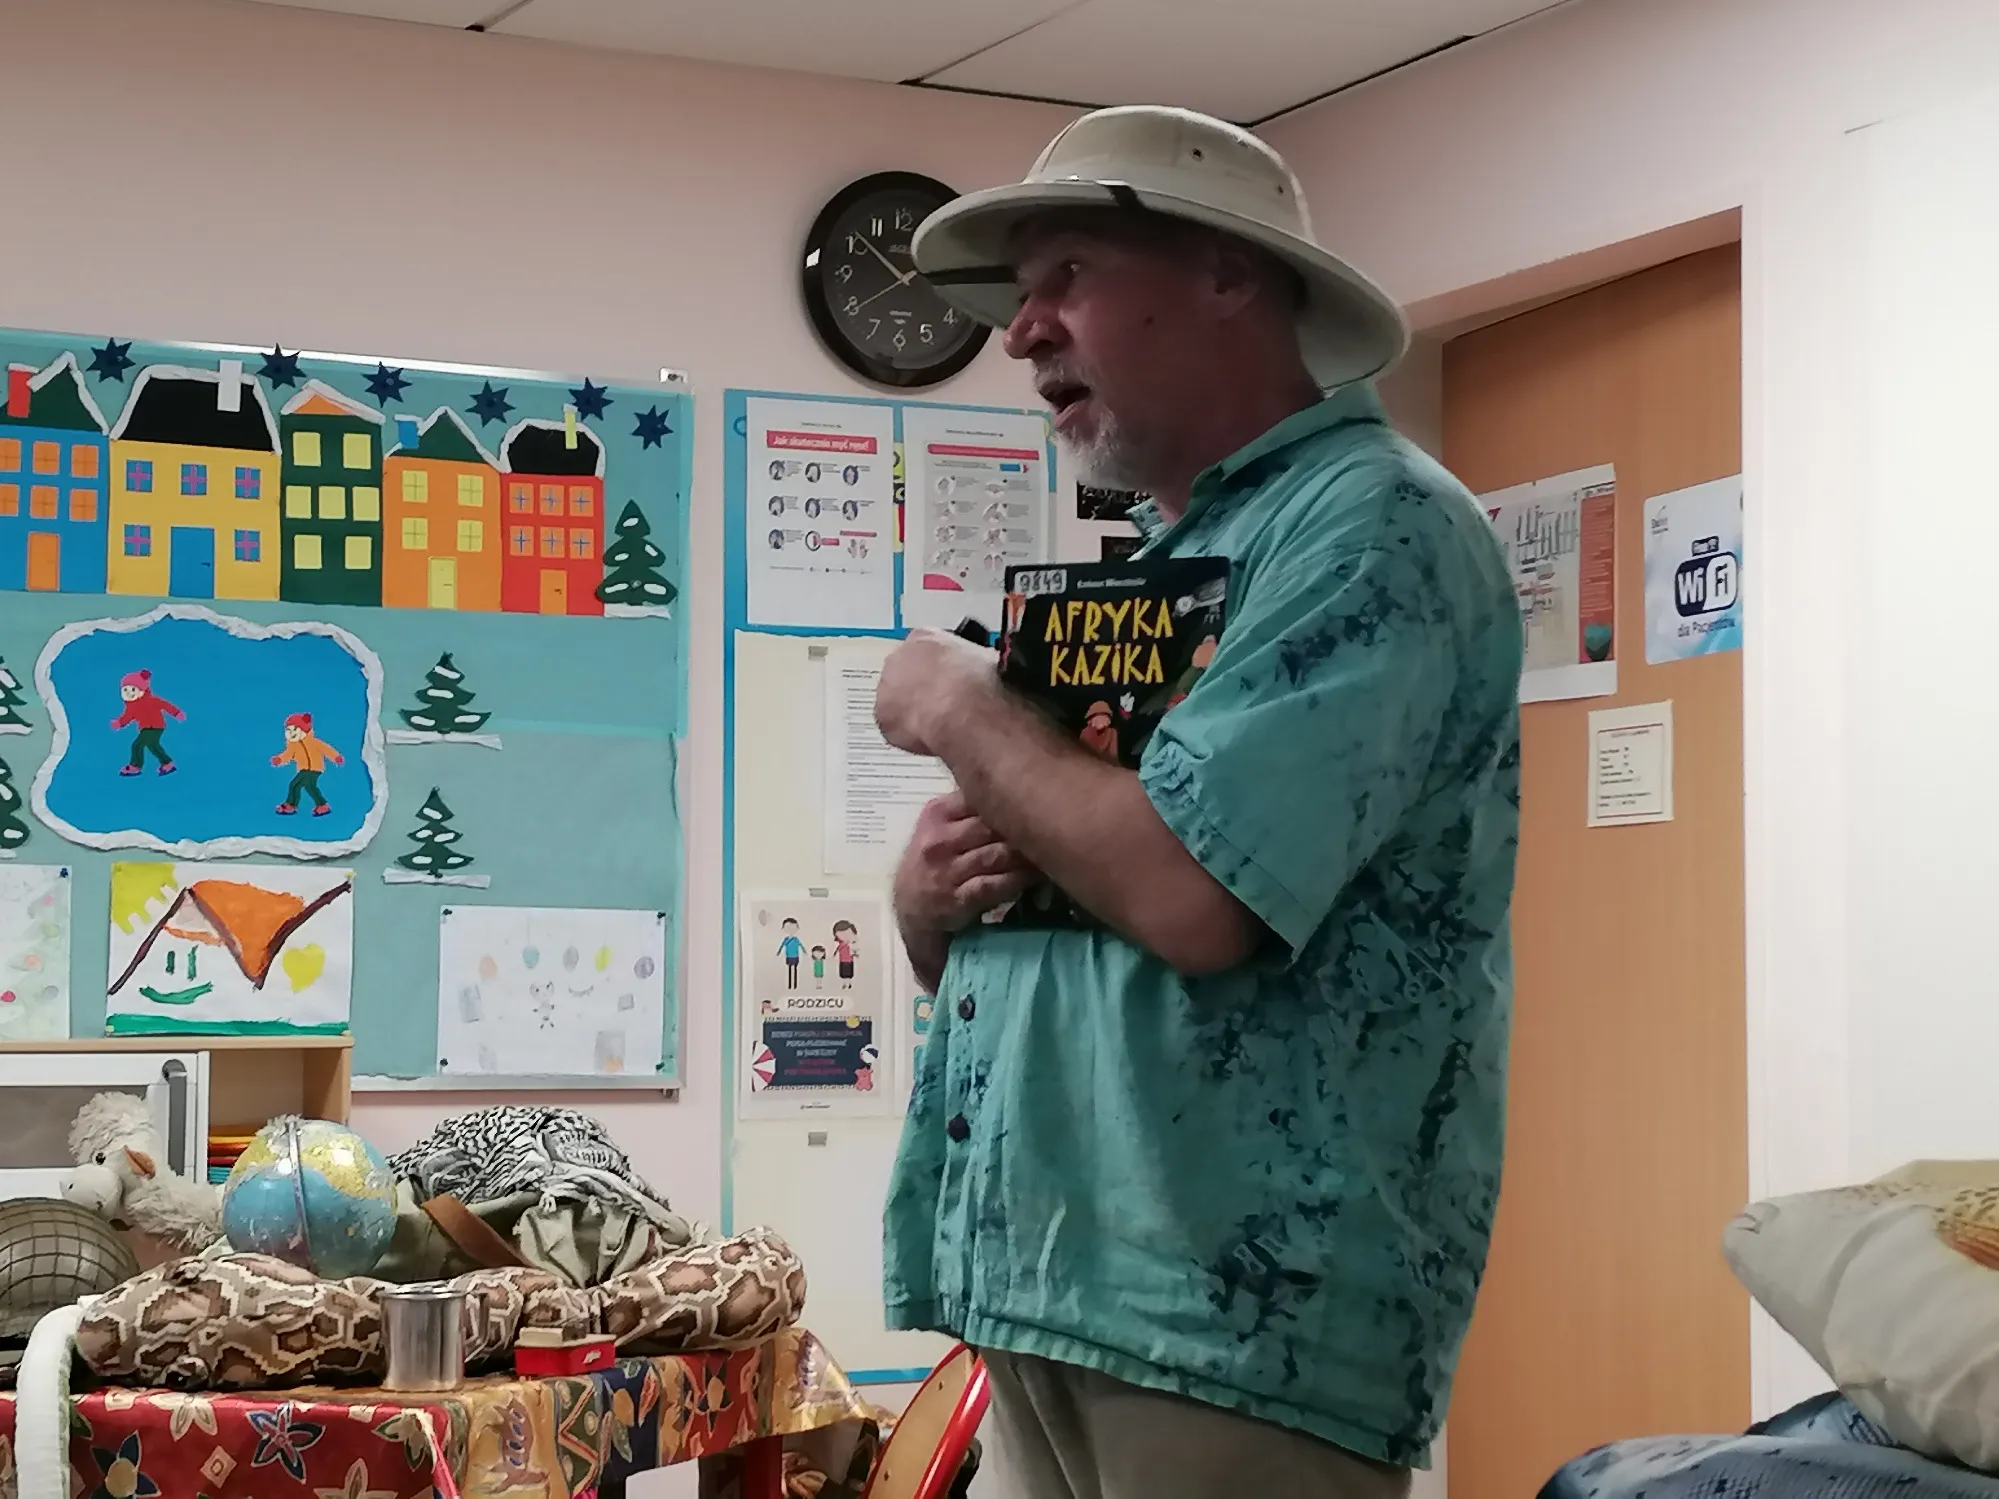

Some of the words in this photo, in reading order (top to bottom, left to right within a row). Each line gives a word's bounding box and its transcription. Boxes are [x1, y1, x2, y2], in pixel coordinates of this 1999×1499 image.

[872, 217, 883, 237] 11
[895, 208, 913, 232] 12
[835, 263, 853, 284] 9
[842, 295, 860, 316] 8
[943, 307, 955, 327] 4
[866, 318, 881, 340] 7
[920, 323, 934, 344] 5
[892, 328, 907, 352] 6
[1043, 597, 1174, 644] AFRYKA
[787, 998, 844, 1009] RODZICU
